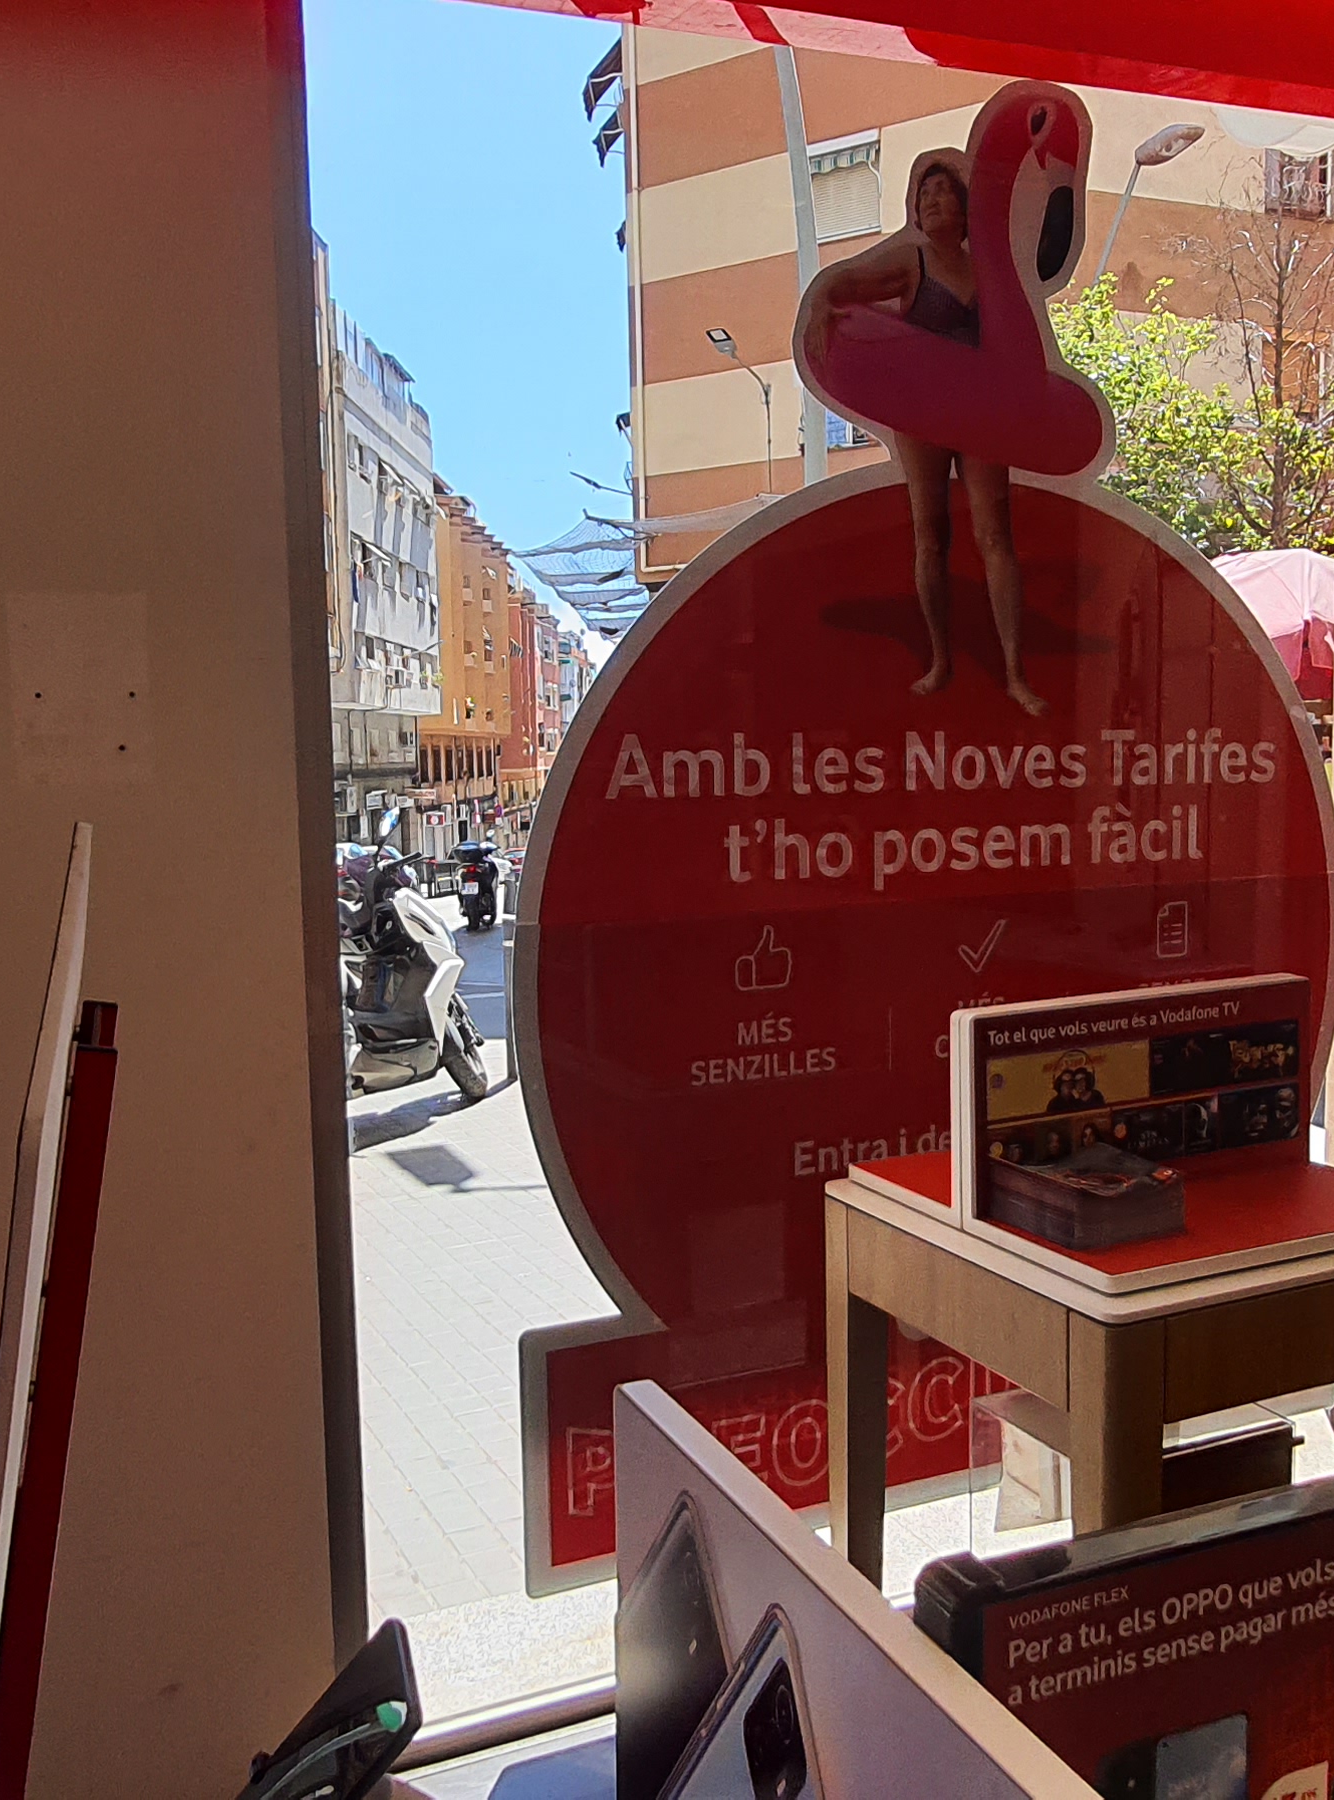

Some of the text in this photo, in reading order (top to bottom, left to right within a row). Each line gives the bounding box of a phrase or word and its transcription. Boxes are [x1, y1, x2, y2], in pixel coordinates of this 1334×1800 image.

[606, 727, 1277, 801] Amb les Noves Tarifes
[873, 822, 1071, 891] posem
[1088, 803, 1204, 866] fàcil
[735, 1015, 793, 1046] MÉS
[987, 1001, 1241, 1046] Tot el que vols veure és a Vodafone TV
[689, 1047, 838, 1088] SENZILLES
[794, 1137, 889, 1177] Entra
[898, 1127, 907, 1157] i
[1007, 1635, 1053, 1669] Per
[1057, 1632, 1073, 1654] a
[1078, 1622, 1113, 1649] tu,
[1117, 1606, 1157, 1639] els
[1161, 1582, 1234, 1626] OPPO
[1238, 1573, 1282, 1609] que
[1008, 1585, 1130, 1630] VODAFONE FLEX
[1007, 1684, 1024, 1707] a
[1028, 1651, 1137, 1702] terminis
[1142, 1630, 1216, 1669] sense
[1219, 1610, 1287, 1654] pagar
